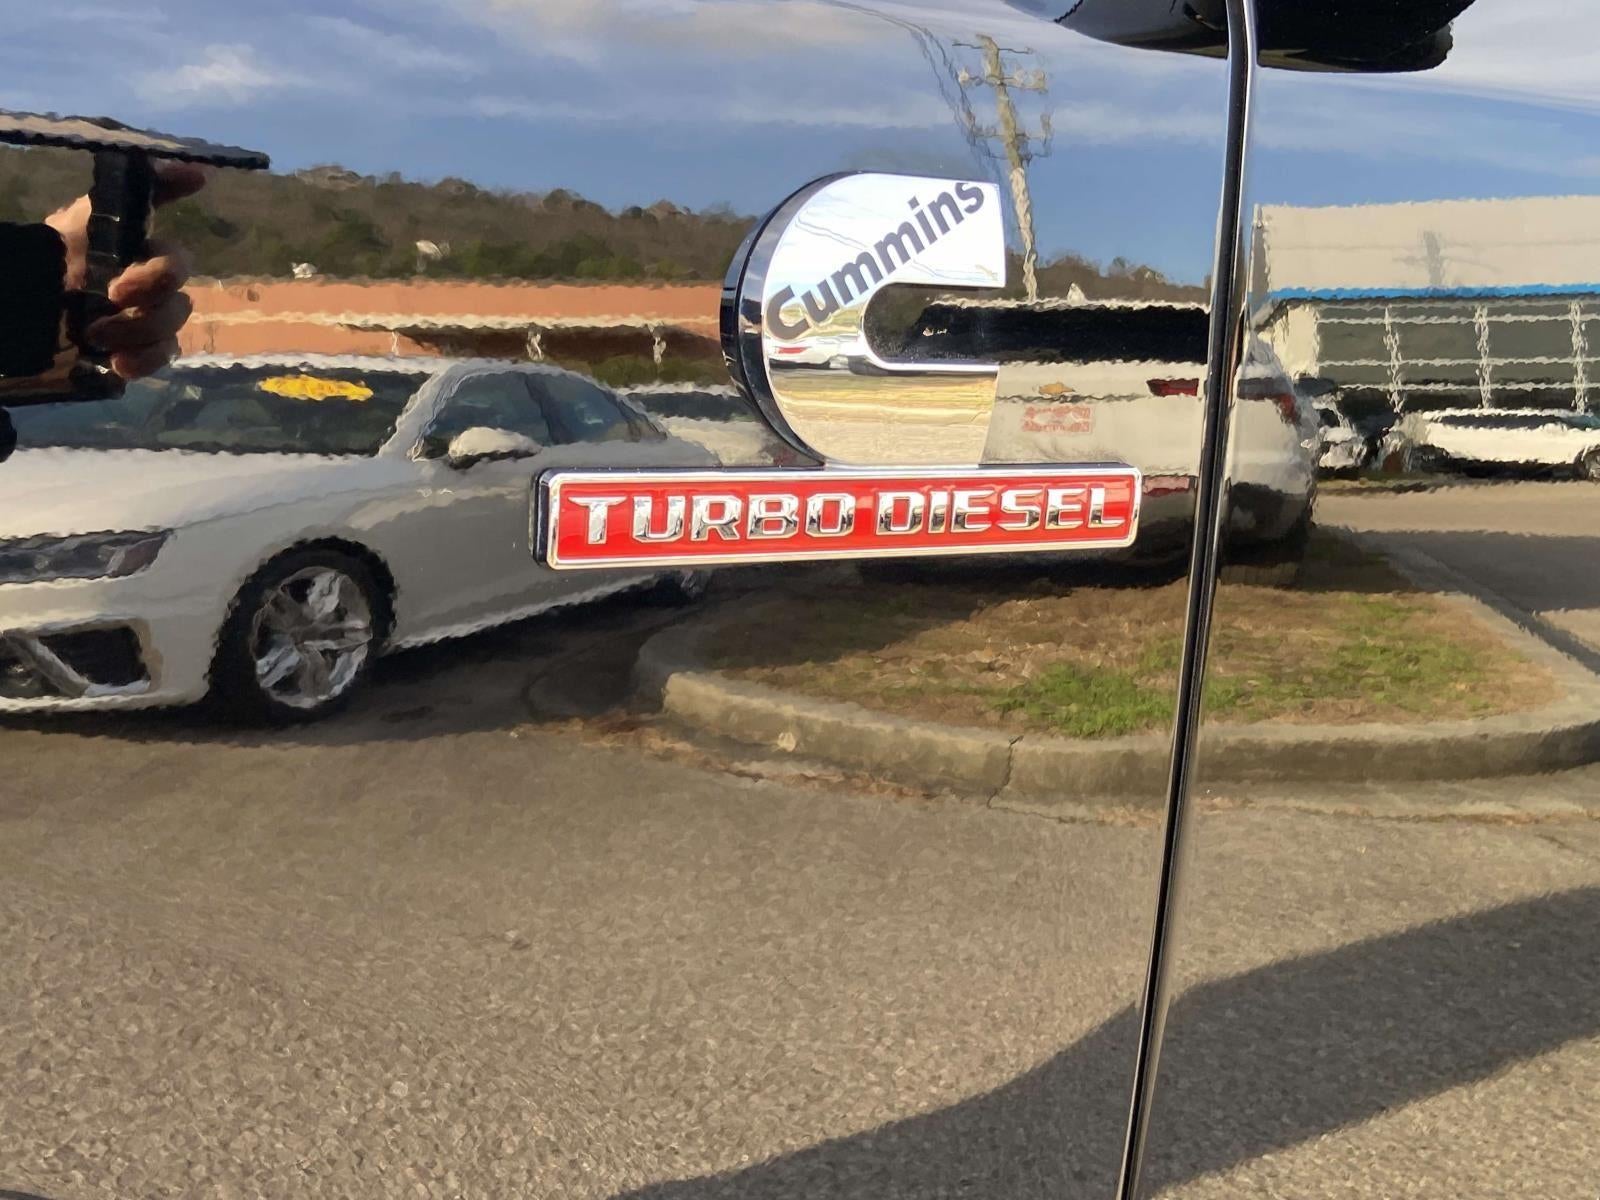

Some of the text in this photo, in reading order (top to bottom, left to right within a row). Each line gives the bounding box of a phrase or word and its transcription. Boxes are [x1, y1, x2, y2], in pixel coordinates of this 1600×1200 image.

[765, 182, 985, 340] Cummins
[568, 487, 1125, 544] TURBO DIESEL
